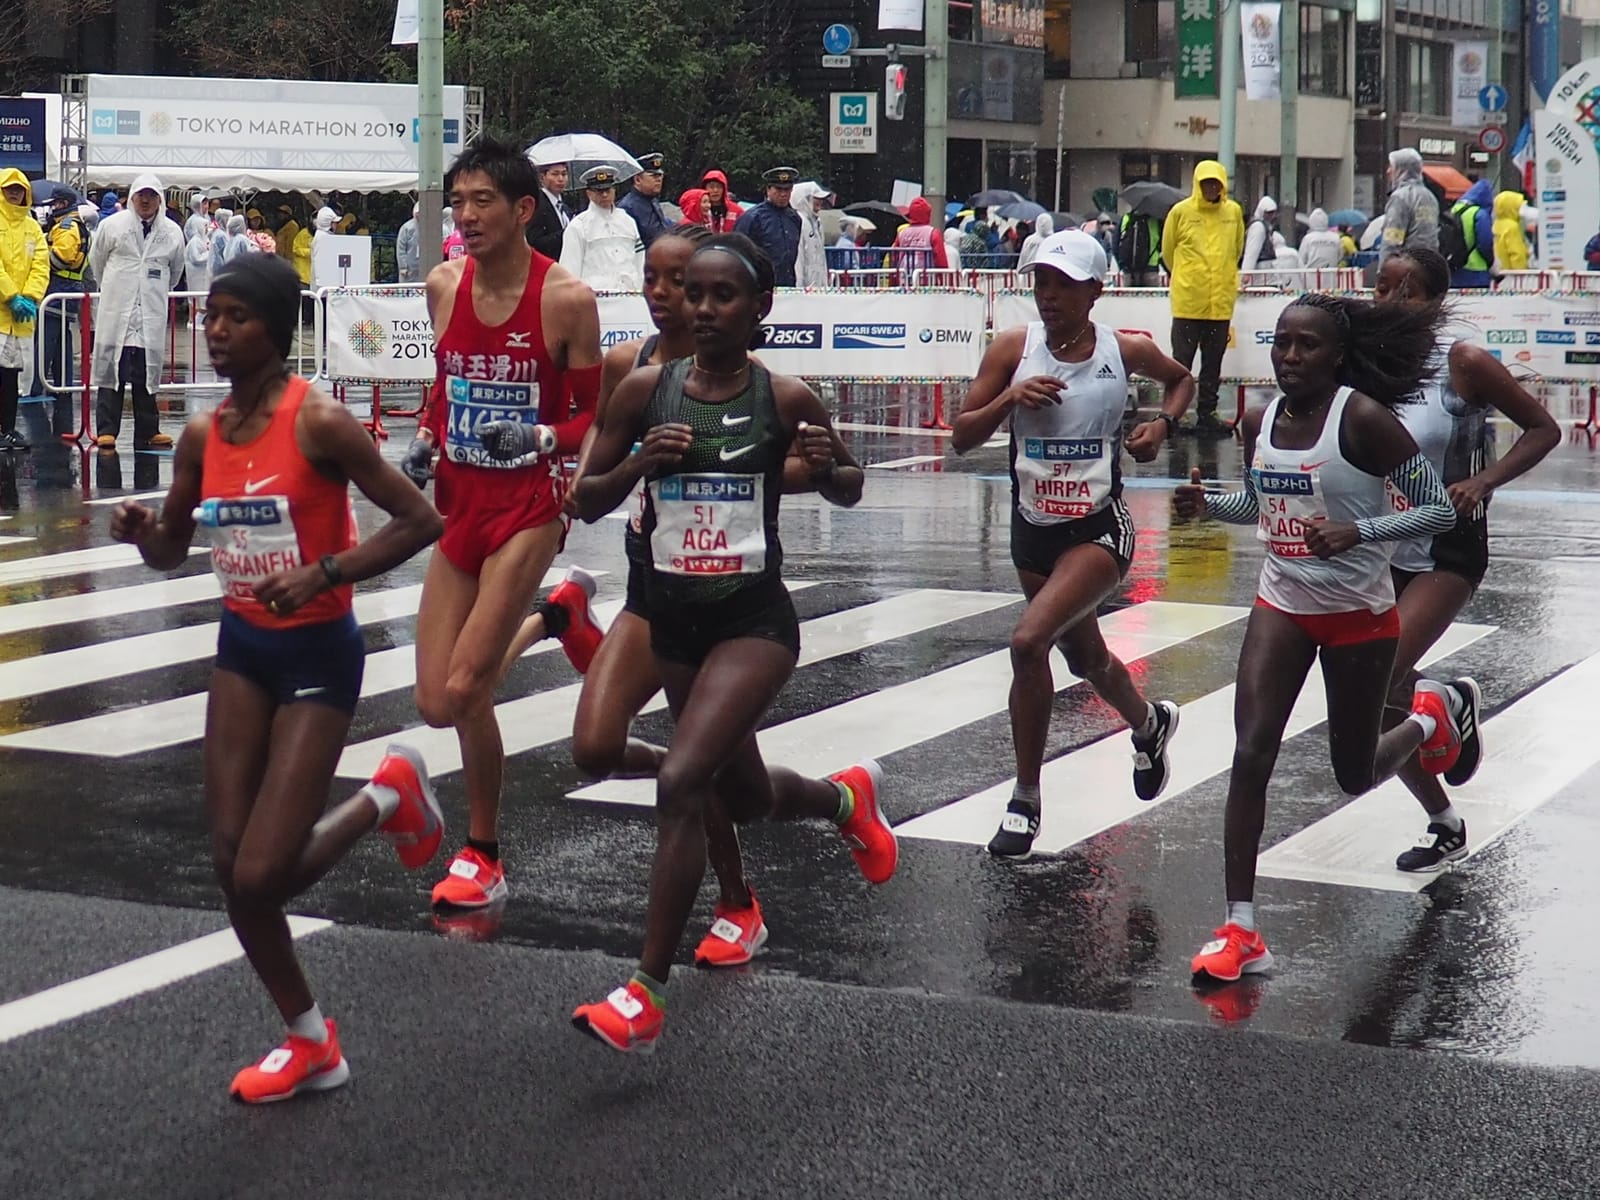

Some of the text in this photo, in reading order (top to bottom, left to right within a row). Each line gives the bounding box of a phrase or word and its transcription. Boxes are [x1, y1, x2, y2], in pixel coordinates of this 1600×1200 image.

[1557, 71, 1591, 102] 10km
[176, 117, 406, 138] TOKYO MARATHON 2019
[1555, 122, 1579, 149] 10km
[1546, 130, 1583, 166] FINISH
[391, 320, 432, 332] TOKY
[834, 326, 905, 335] POCARI SWEAT
[392, 333, 434, 341] MARATHO
[936, 329, 973, 343] BMW
[443, 350, 538, 382] 埼玉滑川
[471, 386, 527, 401] 東京メトロ
[1046, 443, 1099, 455] 東京メトロ
[1053, 463, 1072, 477] 57
[685, 482, 751, 496] 東京メトロ
[1034, 480, 1091, 498] HIRPA
[1262, 477, 1309, 490] 東京メトロ
[1268, 497, 1287, 514] 54
[693, 505, 713, 525] 51
[682, 527, 728, 551] AGA
